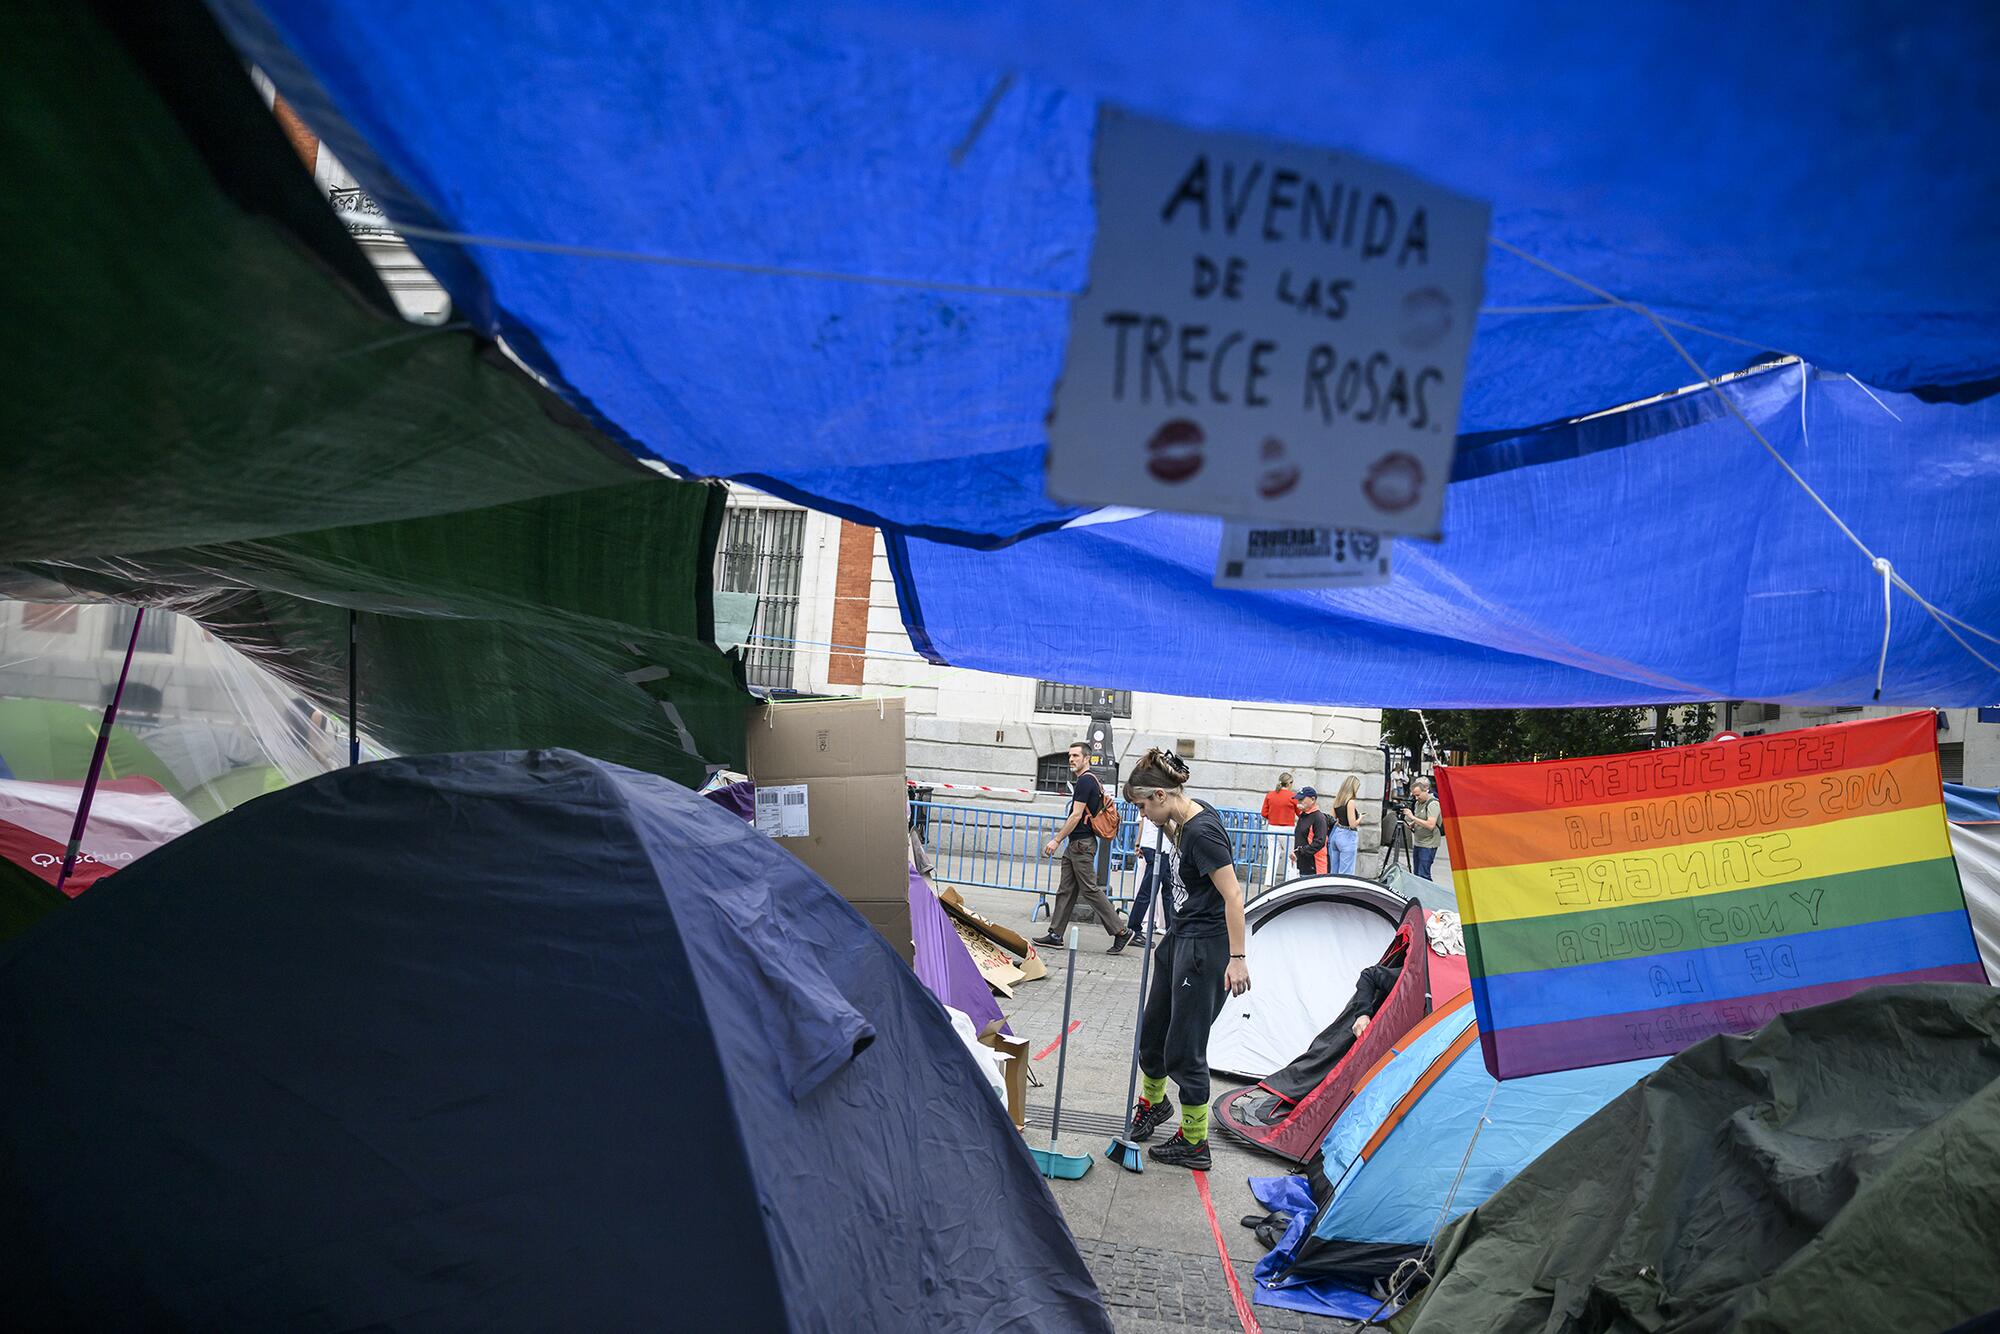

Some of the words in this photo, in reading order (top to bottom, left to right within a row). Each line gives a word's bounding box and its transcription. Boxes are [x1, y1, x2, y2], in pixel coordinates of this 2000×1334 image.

[1161, 153, 1431, 268] AVENIDA
[1192, 254, 1247, 299] DE
[1276, 268, 1355, 322] LAS
[1103, 311, 1277, 408] TRECE
